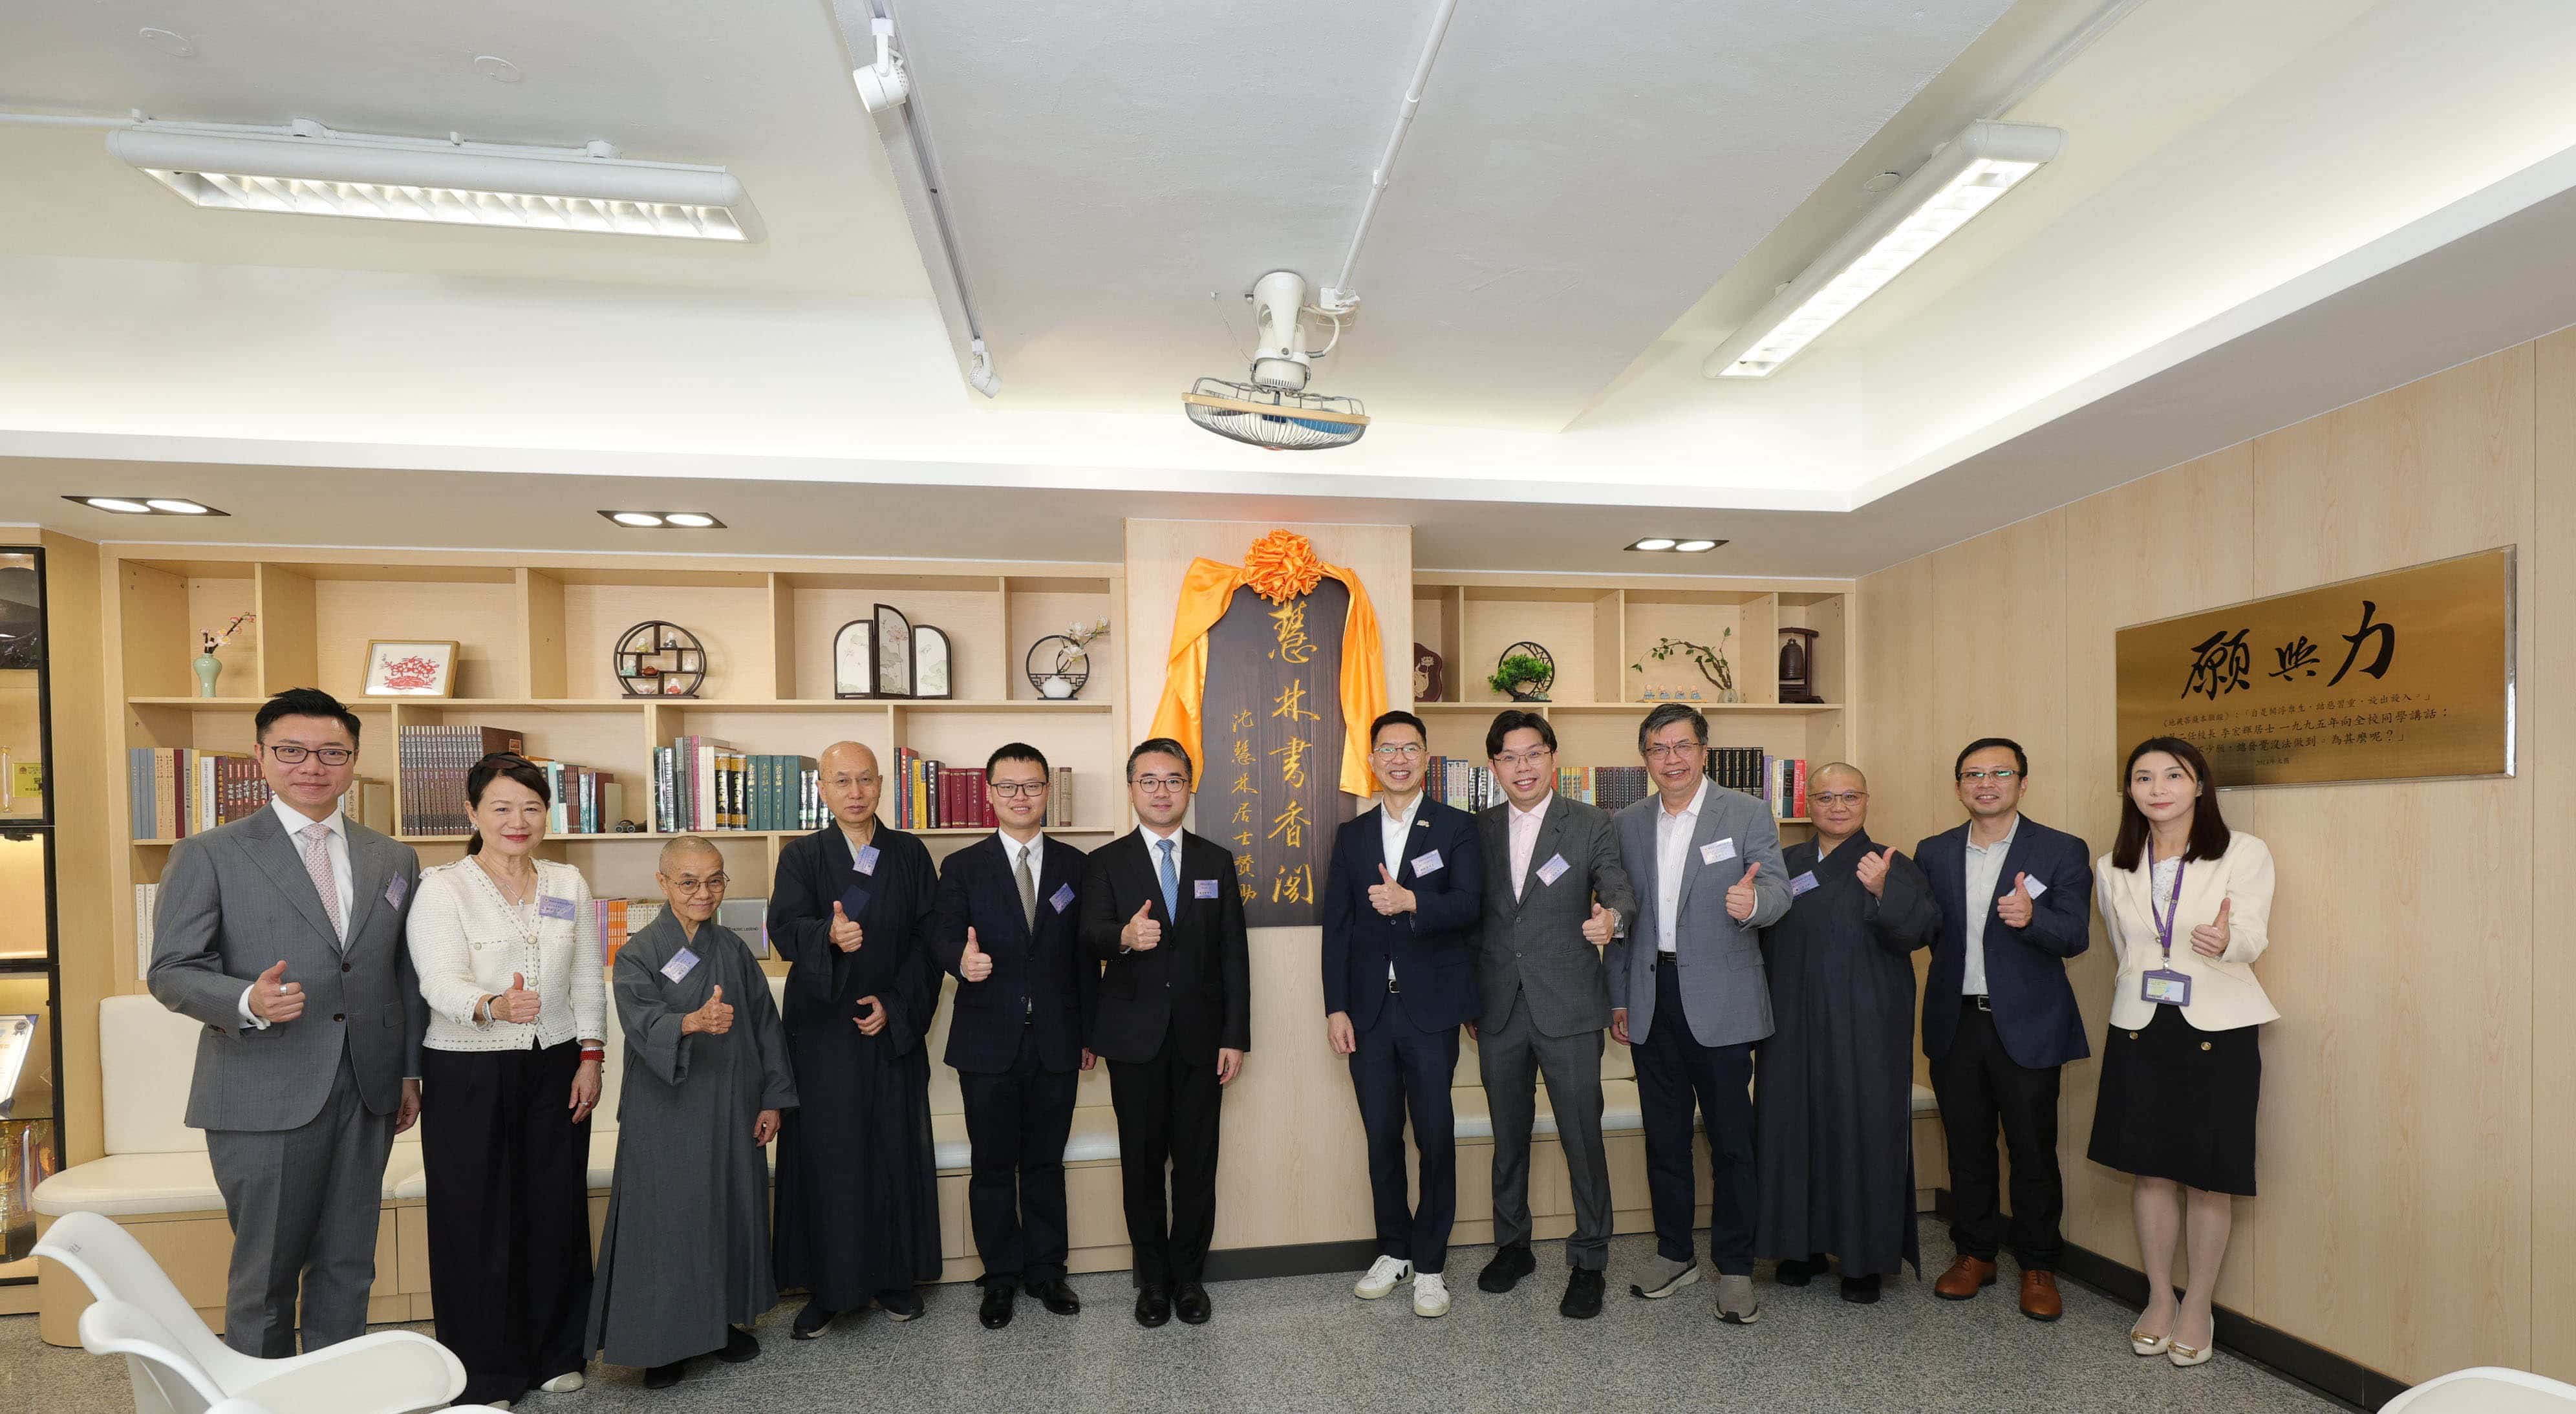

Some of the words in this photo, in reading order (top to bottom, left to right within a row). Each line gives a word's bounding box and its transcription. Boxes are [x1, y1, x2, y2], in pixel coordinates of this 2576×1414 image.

[1267, 599, 1320, 905] 慧林書香閣
